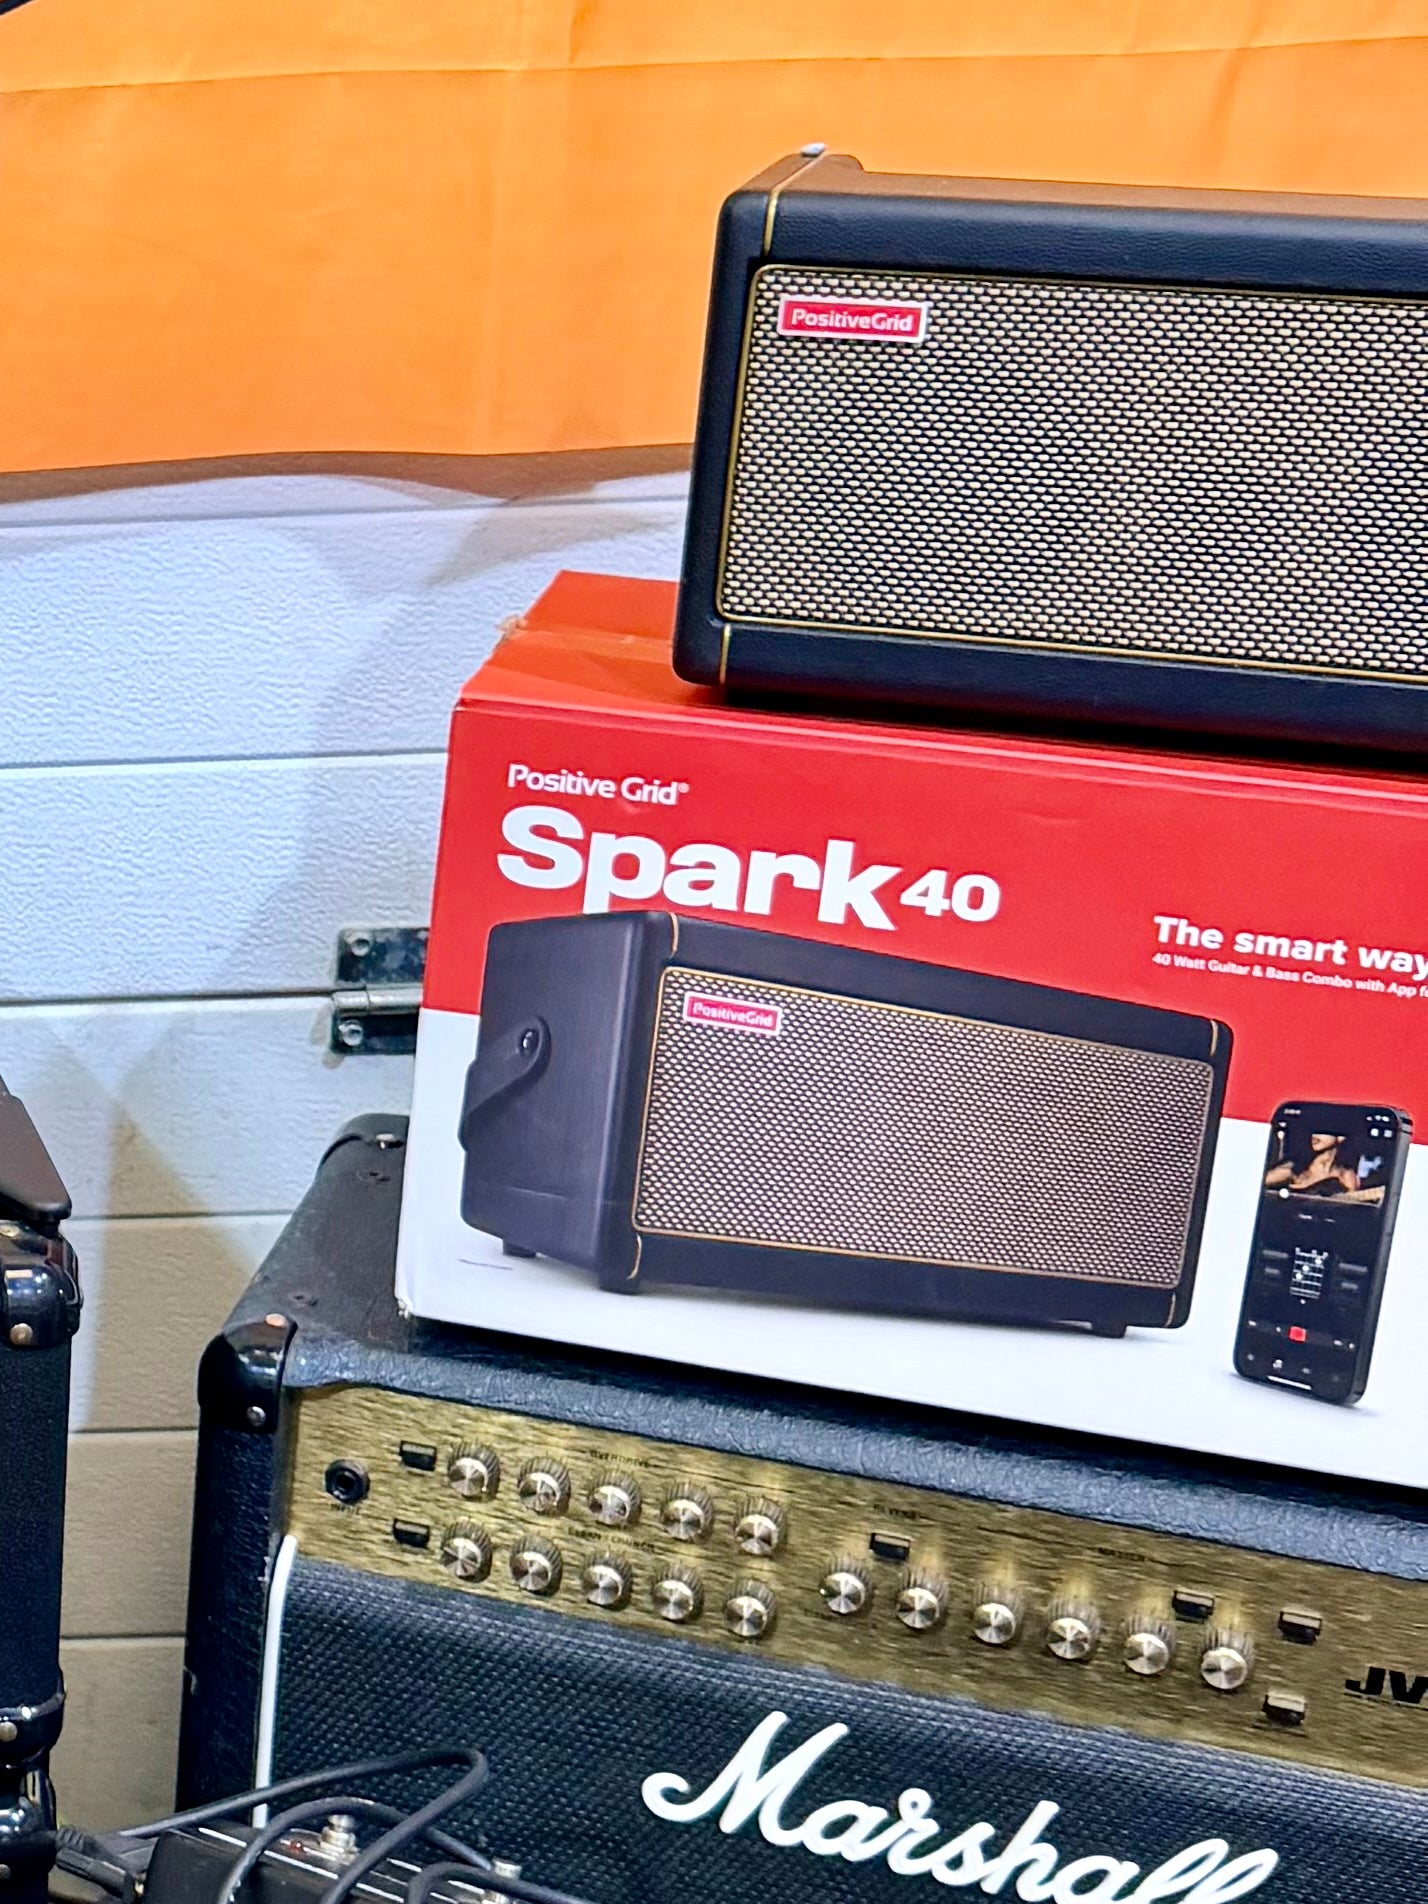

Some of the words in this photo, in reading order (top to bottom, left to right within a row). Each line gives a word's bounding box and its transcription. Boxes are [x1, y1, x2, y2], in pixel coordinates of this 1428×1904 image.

[792, 308, 913, 331] PositiveGrid
[508, 763, 616, 799] Positive
[496, 805, 904, 931] Spark
[899, 869, 1001, 922] 40
[1153, 915, 1224, 950] The
[1234, 931, 1348, 965] smart
[1358, 946, 1428, 981] way
[1152, 953, 1171, 966] 40
[1174, 955, 1205, 970] Watt
[1208, 960, 1250, 976] Guitar
[1251, 965, 1263, 977] &
[1266, 966, 1299, 982] Bass
[1302, 971, 1352, 989] Combo
[1355, 978, 1385, 992] with
[1387, 982, 1417, 998] App
